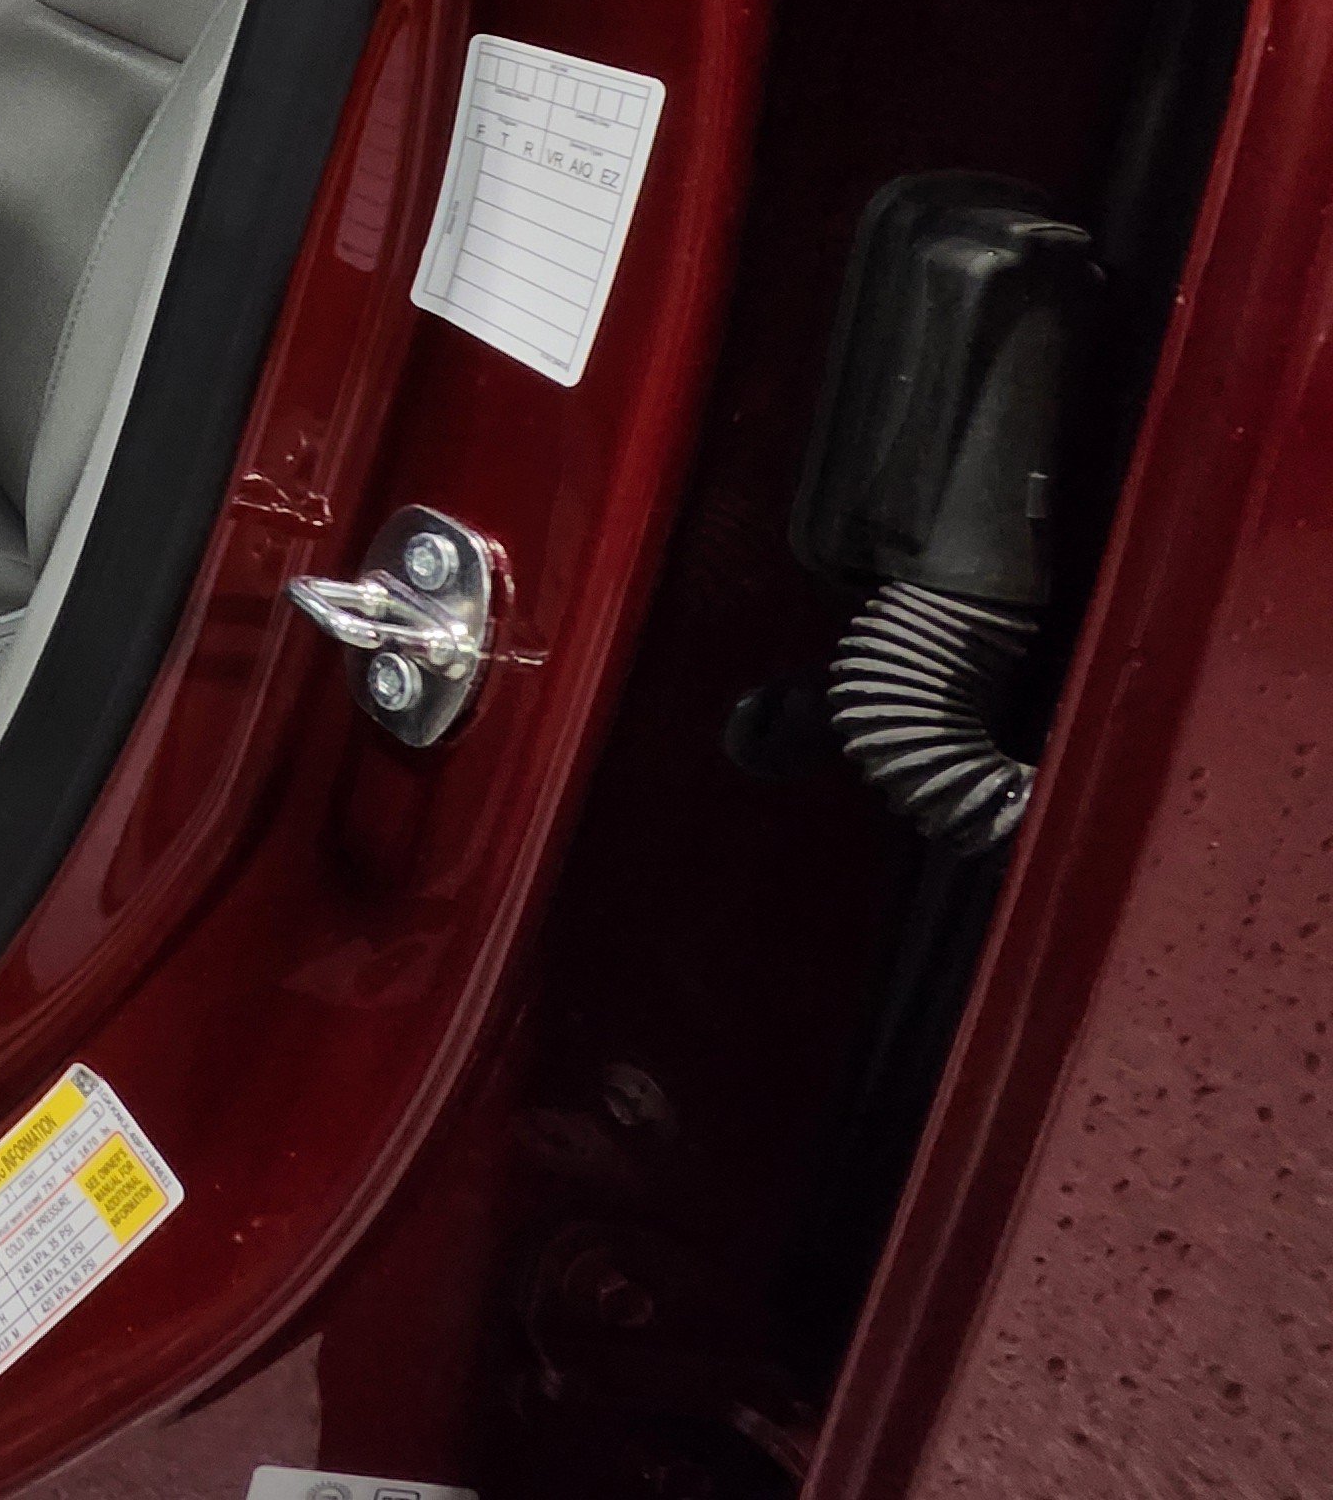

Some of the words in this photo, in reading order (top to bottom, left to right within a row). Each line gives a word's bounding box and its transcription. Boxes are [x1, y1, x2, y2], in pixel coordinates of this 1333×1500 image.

[500, 132, 510, 147] T
[522, 141, 534, 157] R
[546, 149, 564, 169] VR
[599, 168, 621, 189] EZ
[0, 1112, 59, 1172] INFORMATION
[83, 1174, 101, 1193] SEE
[95, 1146, 129, 1180] OWNER'S
[92, 1173, 122, 1203] MANUAL
[117, 1159, 135, 1178] FOR
[102, 1174, 142, 1214] ADDITIONAL
[108, 1182, 155, 1228] INFORMATION
[3, 1235, 26, 1260] COLD
[21, 1222, 40, 1242] TIRE
[33, 1191, 72, 1230] PRESSURE
[16, 1261, 33, 1279] 240
[47, 1236, 60, 1251] 35
[57, 1222, 74, 1240] PSI
[27, 1278, 45, 1298] 240
[58, 1253, 72, 1268] 35
[68, 1239, 86, 1258] PSI
[80, 1256, 97, 1275] PSI
